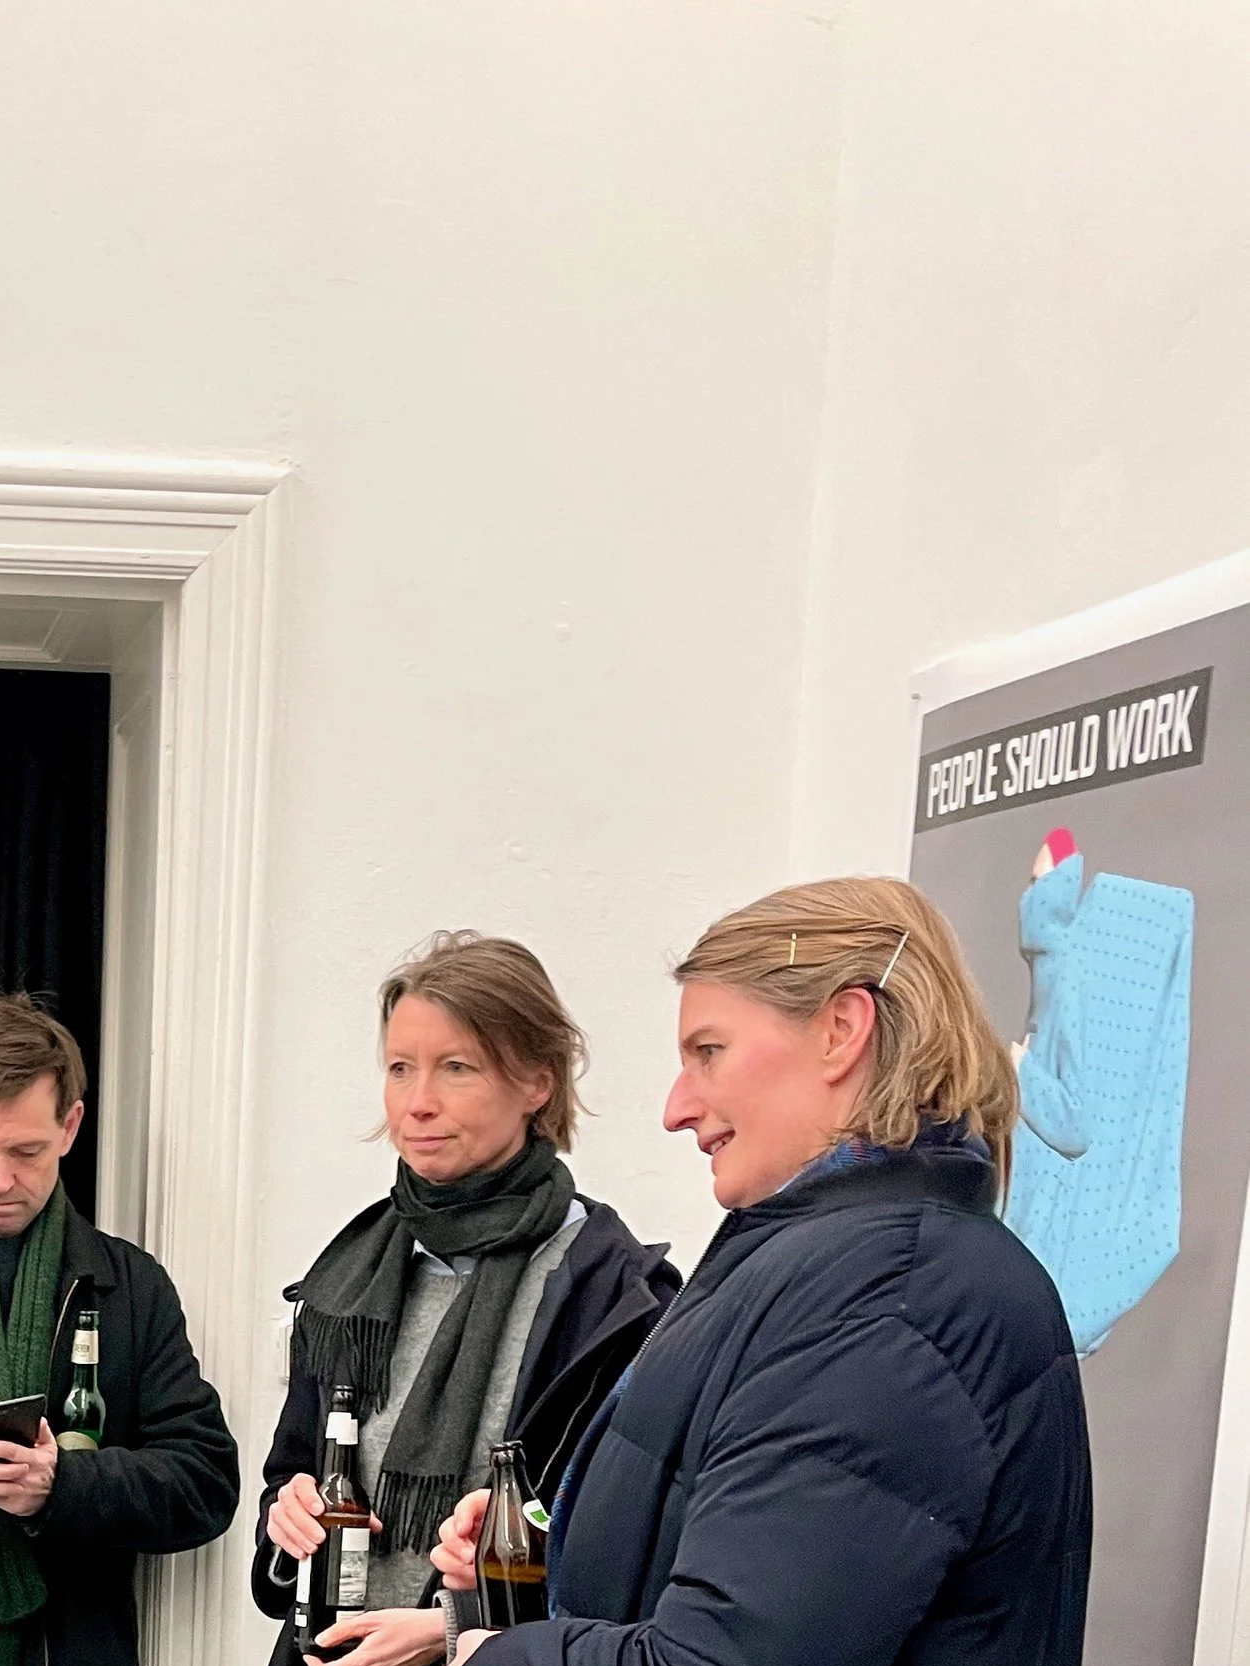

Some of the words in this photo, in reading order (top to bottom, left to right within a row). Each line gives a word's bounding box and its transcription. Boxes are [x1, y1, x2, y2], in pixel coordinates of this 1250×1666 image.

[926, 742, 1002, 819] PEOPLE
[1002, 714, 1101, 797] SHOULD
[1106, 685, 1200, 771] WORK
